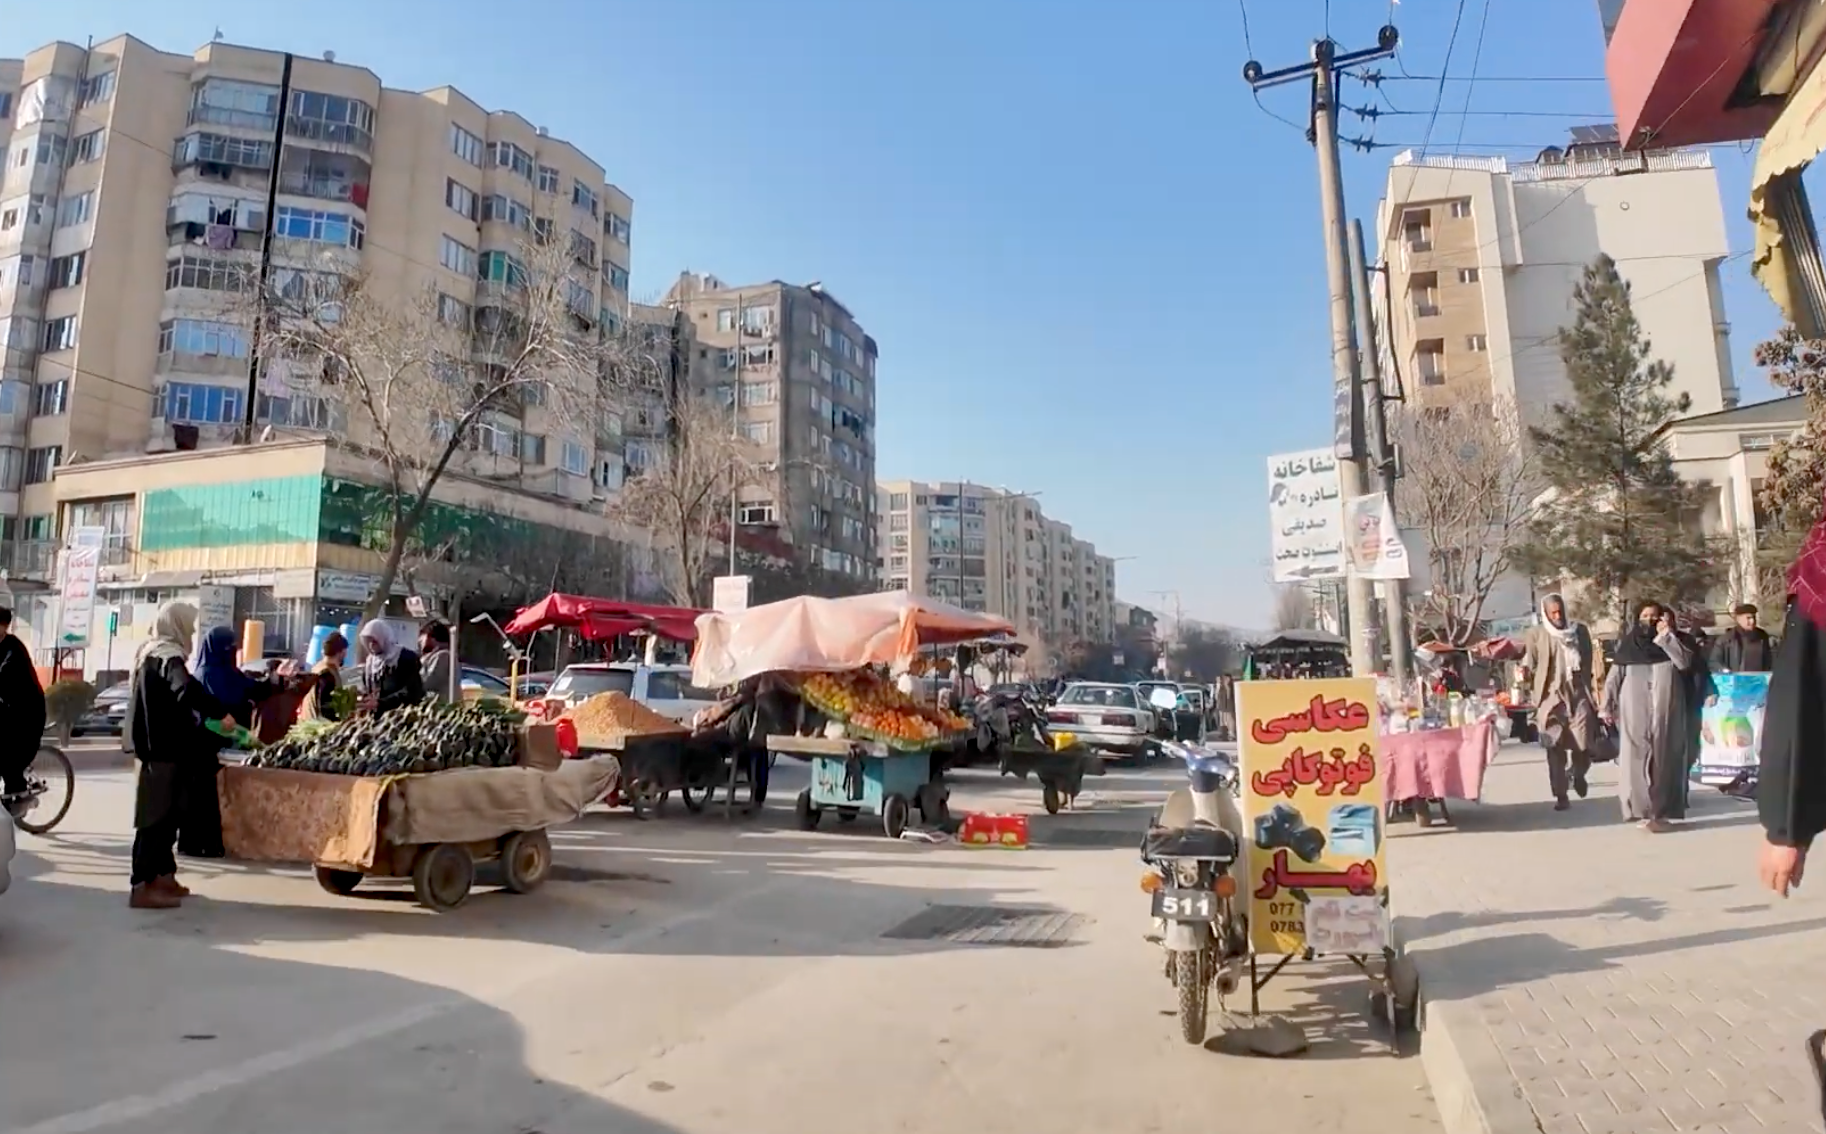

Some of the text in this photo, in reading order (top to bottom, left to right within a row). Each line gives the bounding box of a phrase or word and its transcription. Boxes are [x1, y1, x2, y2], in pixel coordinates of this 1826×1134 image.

[1274, 455, 1335, 479] شفاخانه
[1251, 693, 1370, 744] عکاسی
[1251, 743, 1376, 798] فوتوکاپی
[1162, 896, 1209, 916] 511
[1269, 902, 1295, 915] 077
